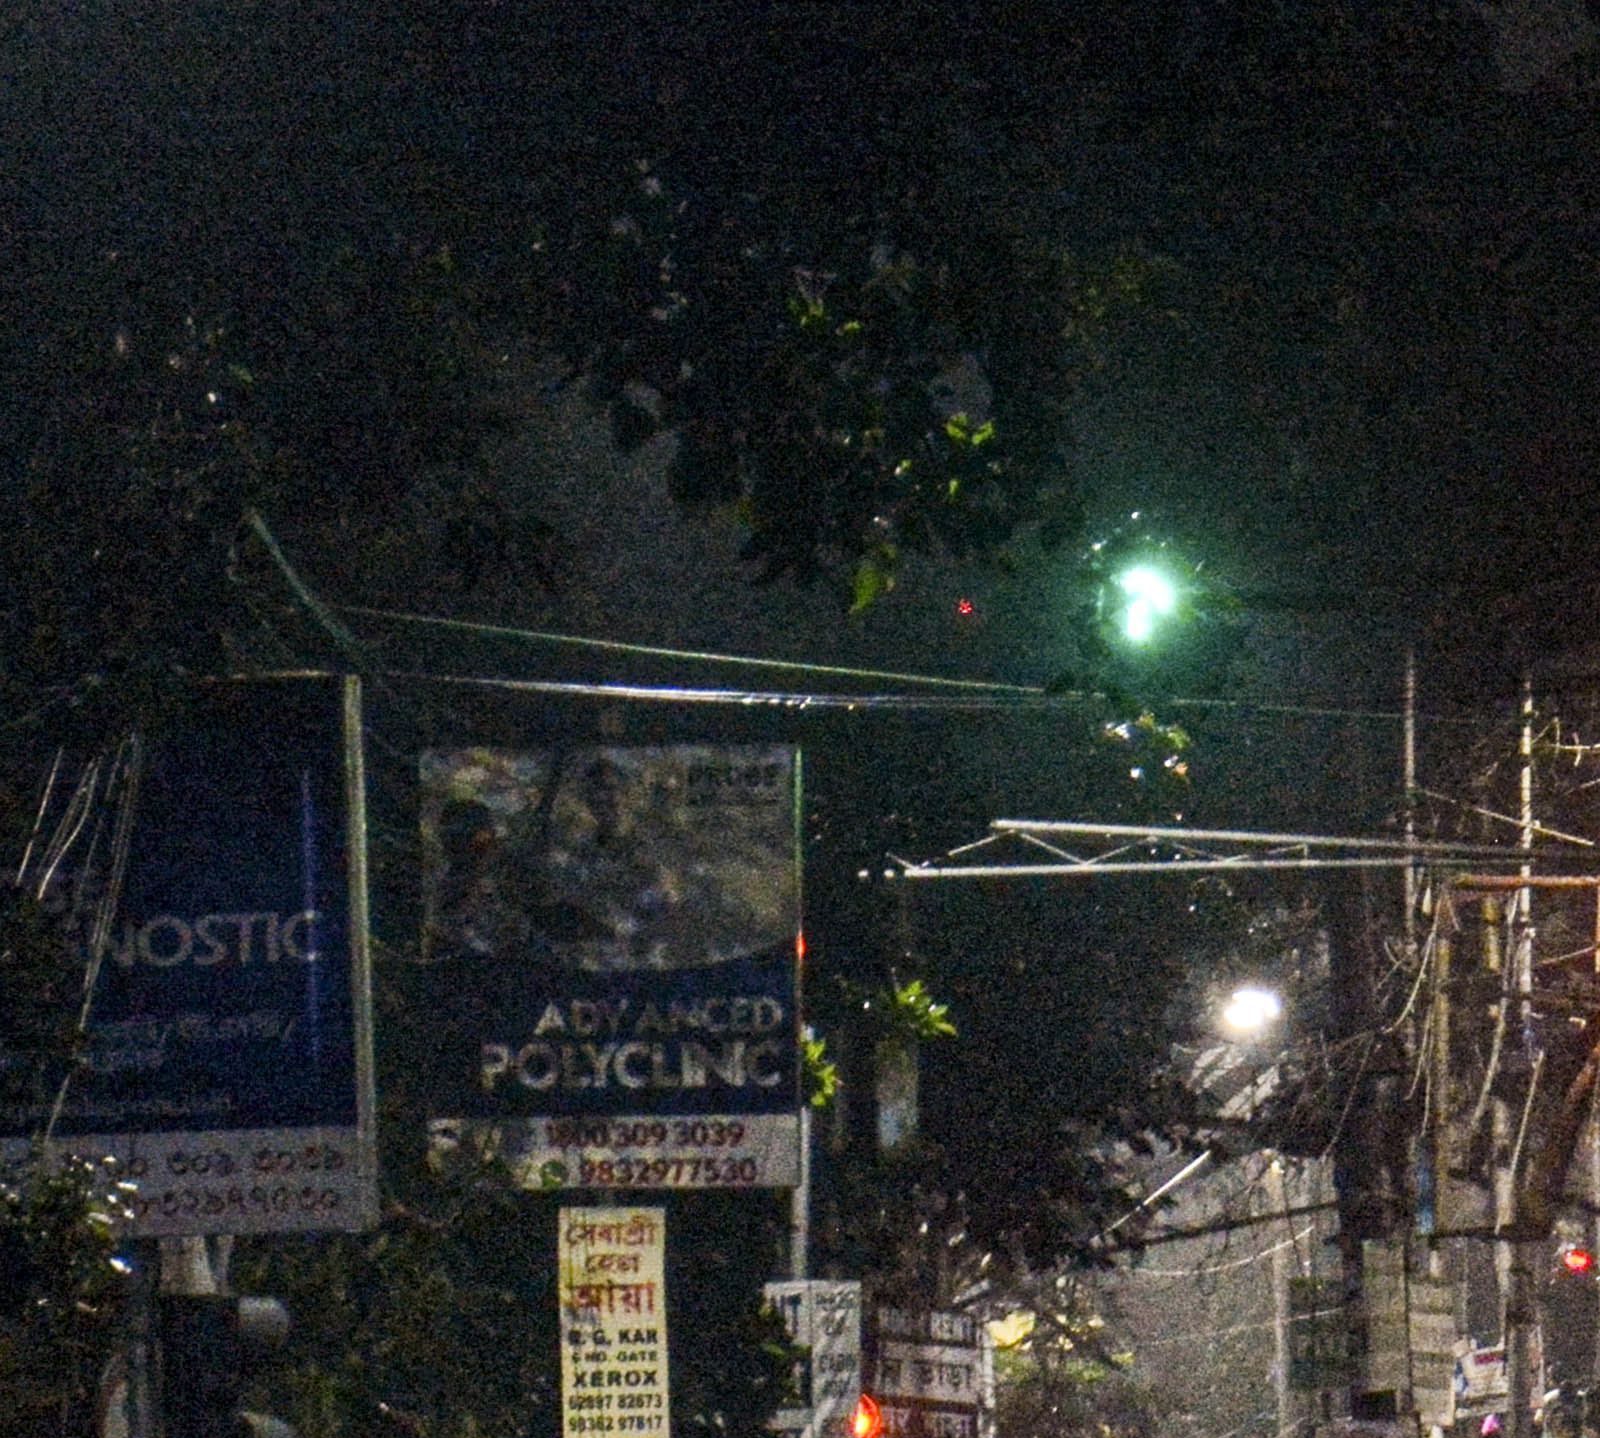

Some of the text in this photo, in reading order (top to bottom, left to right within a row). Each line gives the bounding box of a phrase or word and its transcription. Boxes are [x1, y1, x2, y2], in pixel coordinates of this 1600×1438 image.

[533, 997, 784, 1036] ADVANCED
[480, 1040, 783, 1090] POLYCLINIC
[614, 1122, 667, 1148] 309
[674, 1121, 745, 1147] 3039
[618, 1328, 658, 1346] KAR
[615, 1350, 658, 1363] GATE
[572, 1370, 658, 1388] XEROX
